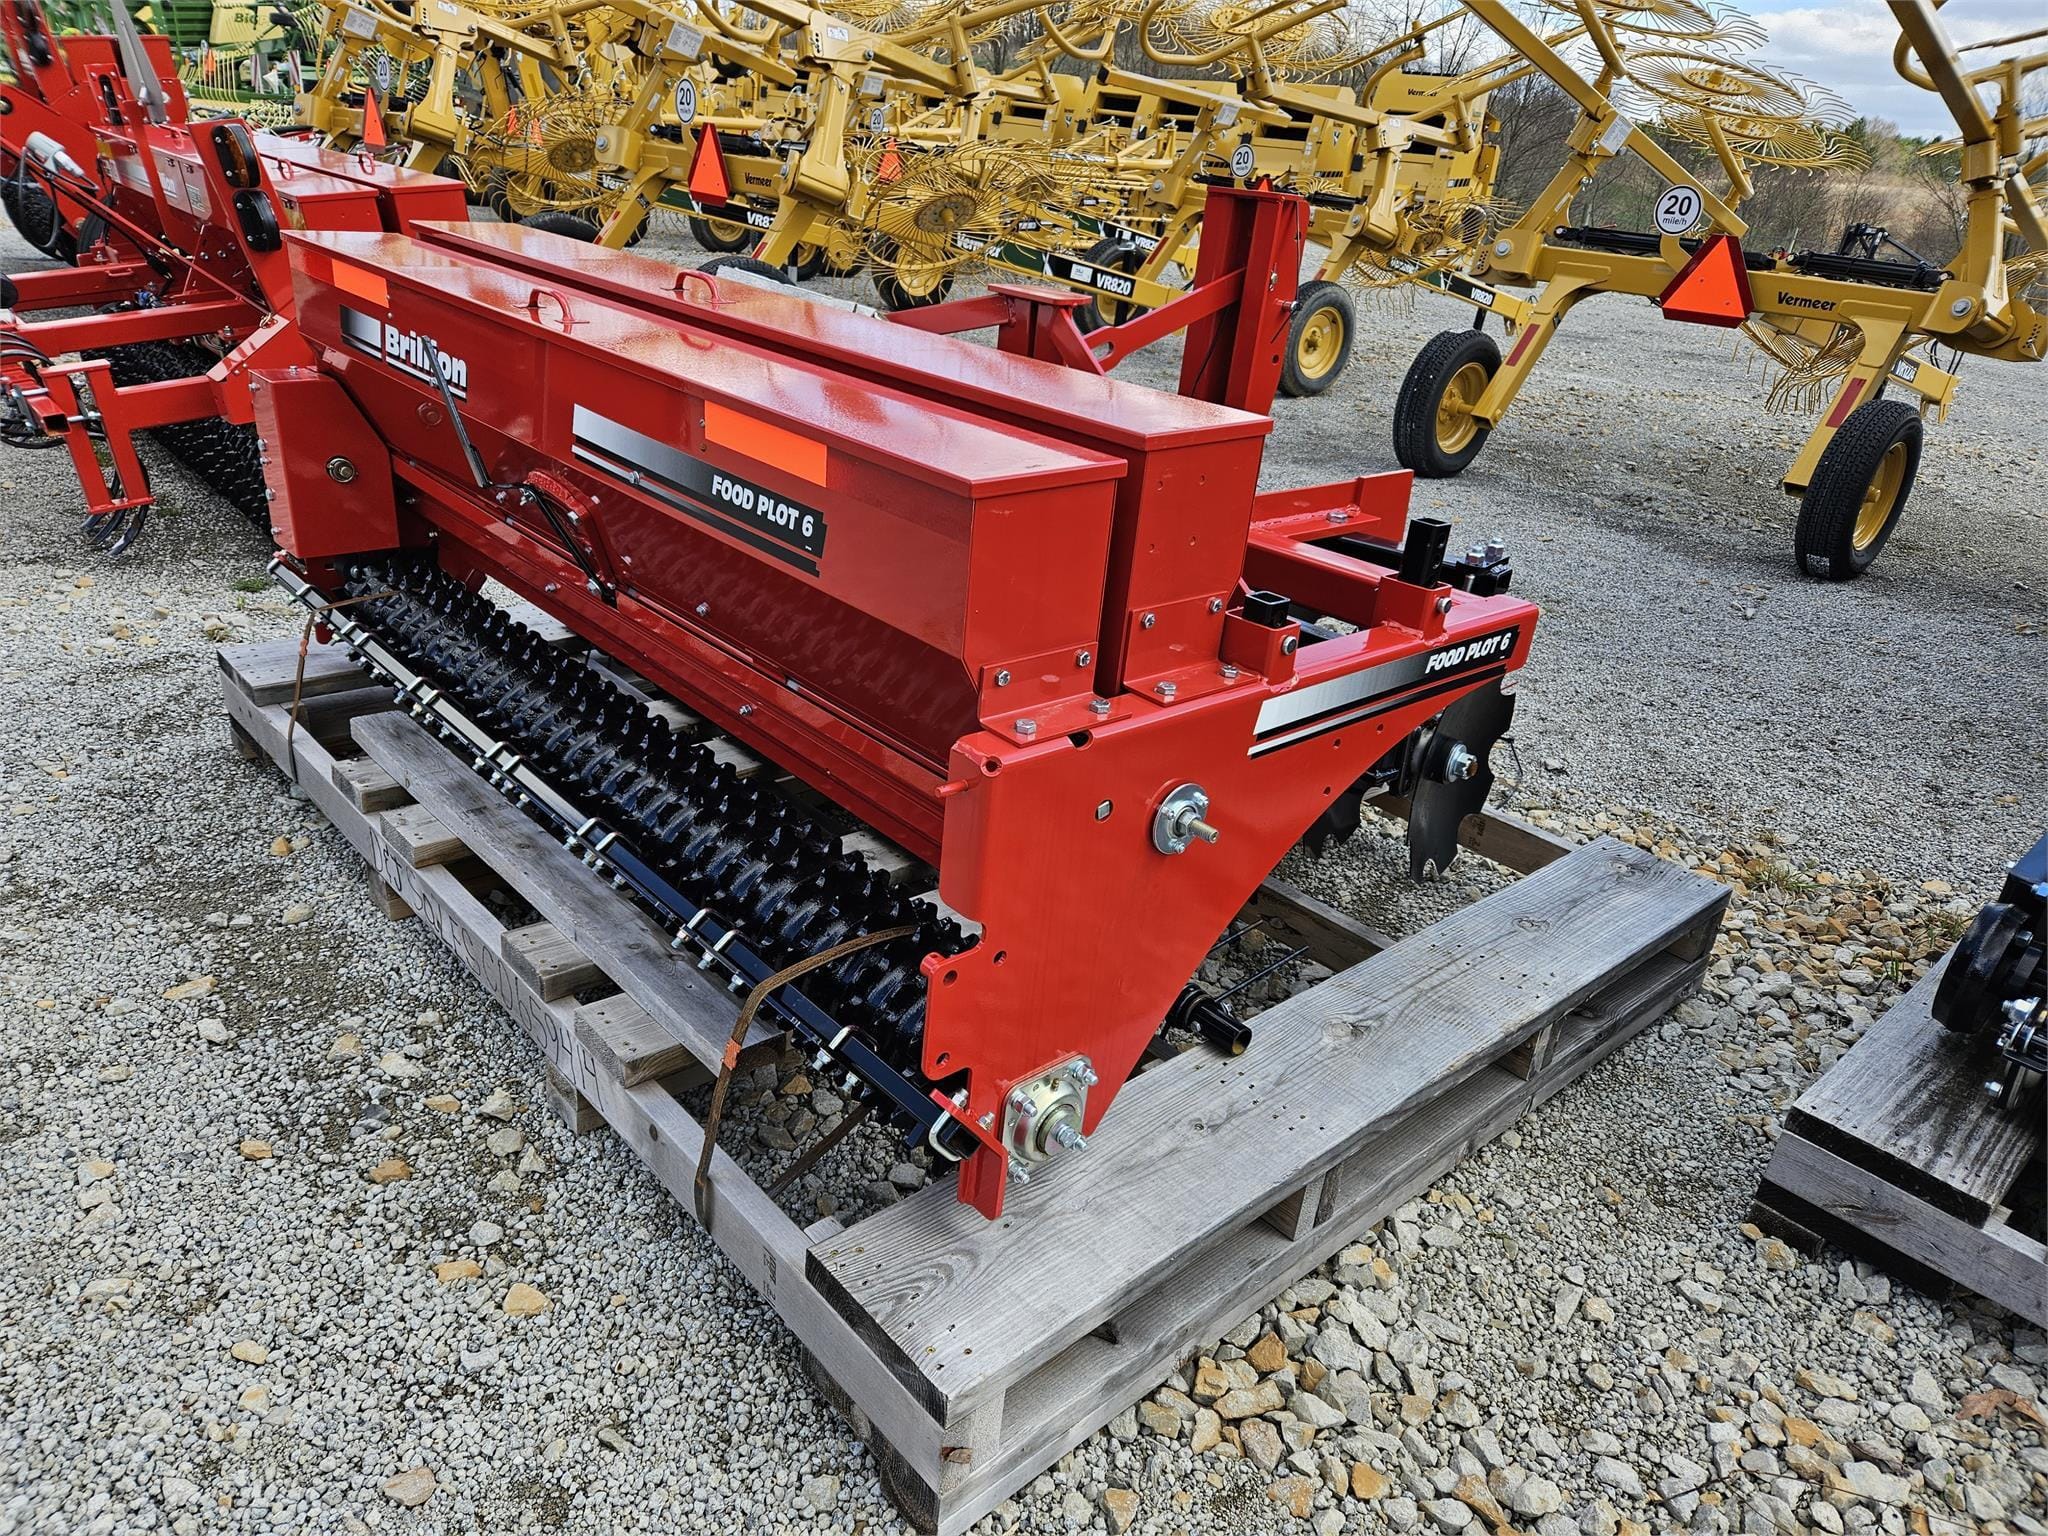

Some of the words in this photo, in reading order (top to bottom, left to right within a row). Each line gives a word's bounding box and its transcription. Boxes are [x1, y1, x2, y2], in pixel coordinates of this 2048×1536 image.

[679, 87, 692, 106] 20
[873, 113, 883, 125] 20
[1235, 150, 1250, 166] 20
[744, 172, 772, 187] Vermeer
[1663, 194, 1693, 217] 20
[1662, 216, 1688, 226] mile/h
[1096, 272, 1132, 297] VR820
[1777, 291, 1837, 312] Vermeer
[711, 474, 753, 511] FOOD
[756, 493, 800, 531] PLOT
[801, 514, 815, 538] 6
[1424, 646, 1466, 674] FOOD
[1464, 635, 1502, 662] PLOT
[1499, 631, 1512, 651] 6
